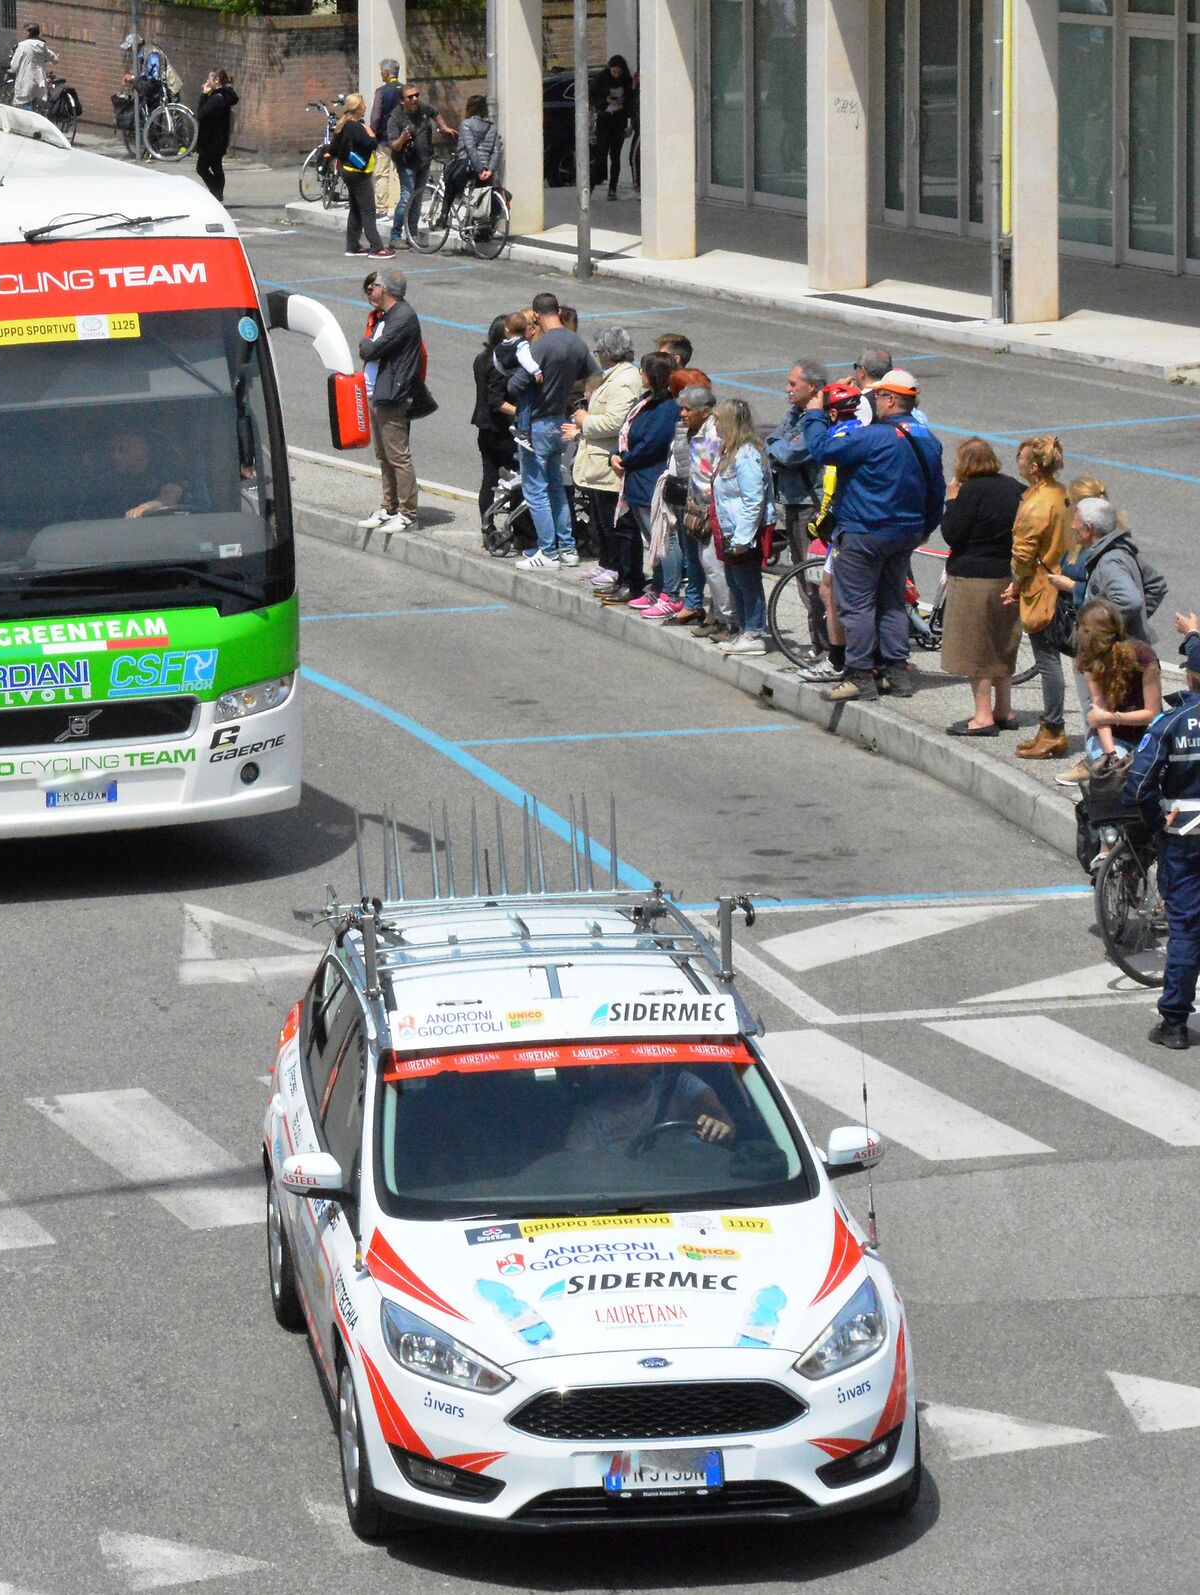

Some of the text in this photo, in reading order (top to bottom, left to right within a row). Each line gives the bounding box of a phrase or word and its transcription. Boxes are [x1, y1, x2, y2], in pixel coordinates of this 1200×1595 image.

[99, 262, 207, 289] TEAM
[26, 323, 76, 336] SPORTIVO
[111, 320, 136, 331] 1125
[108, 652, 186, 688] CSF
[1187, 718, 1200, 731] P
[20, 754, 120, 775] CYCLING
[124, 748, 197, 767] TEAM
[426, 1010, 492, 1025] ANDRONI
[508, 1011, 543, 1020] UNICO
[609, 1002, 726, 1022] SIDERMEC
[417, 1021, 504, 1038] GIOCATTOLI
[453, 1052, 500, 1066] LAURETANA
[513, 1050, 560, 1062] LAURETANA
[283, 1174, 321, 1186] ASTEEL
[523, 1216, 670, 1234] GRUPPO SPORTIVO
[728, 1219, 765, 1229] 1107
[477, 1232, 511, 1242] Giro d'Italia
[544, 1242, 656, 1259] ANDRONI
[682, 1244, 736, 1256] UNICO
[529, 1251, 675, 1271] GIOCATTOLI
[567, 1271, 738, 1294] SIDERMEC
[595, 1304, 688, 1324] LAURETANA
[643, 1358, 667, 1369] Ford
